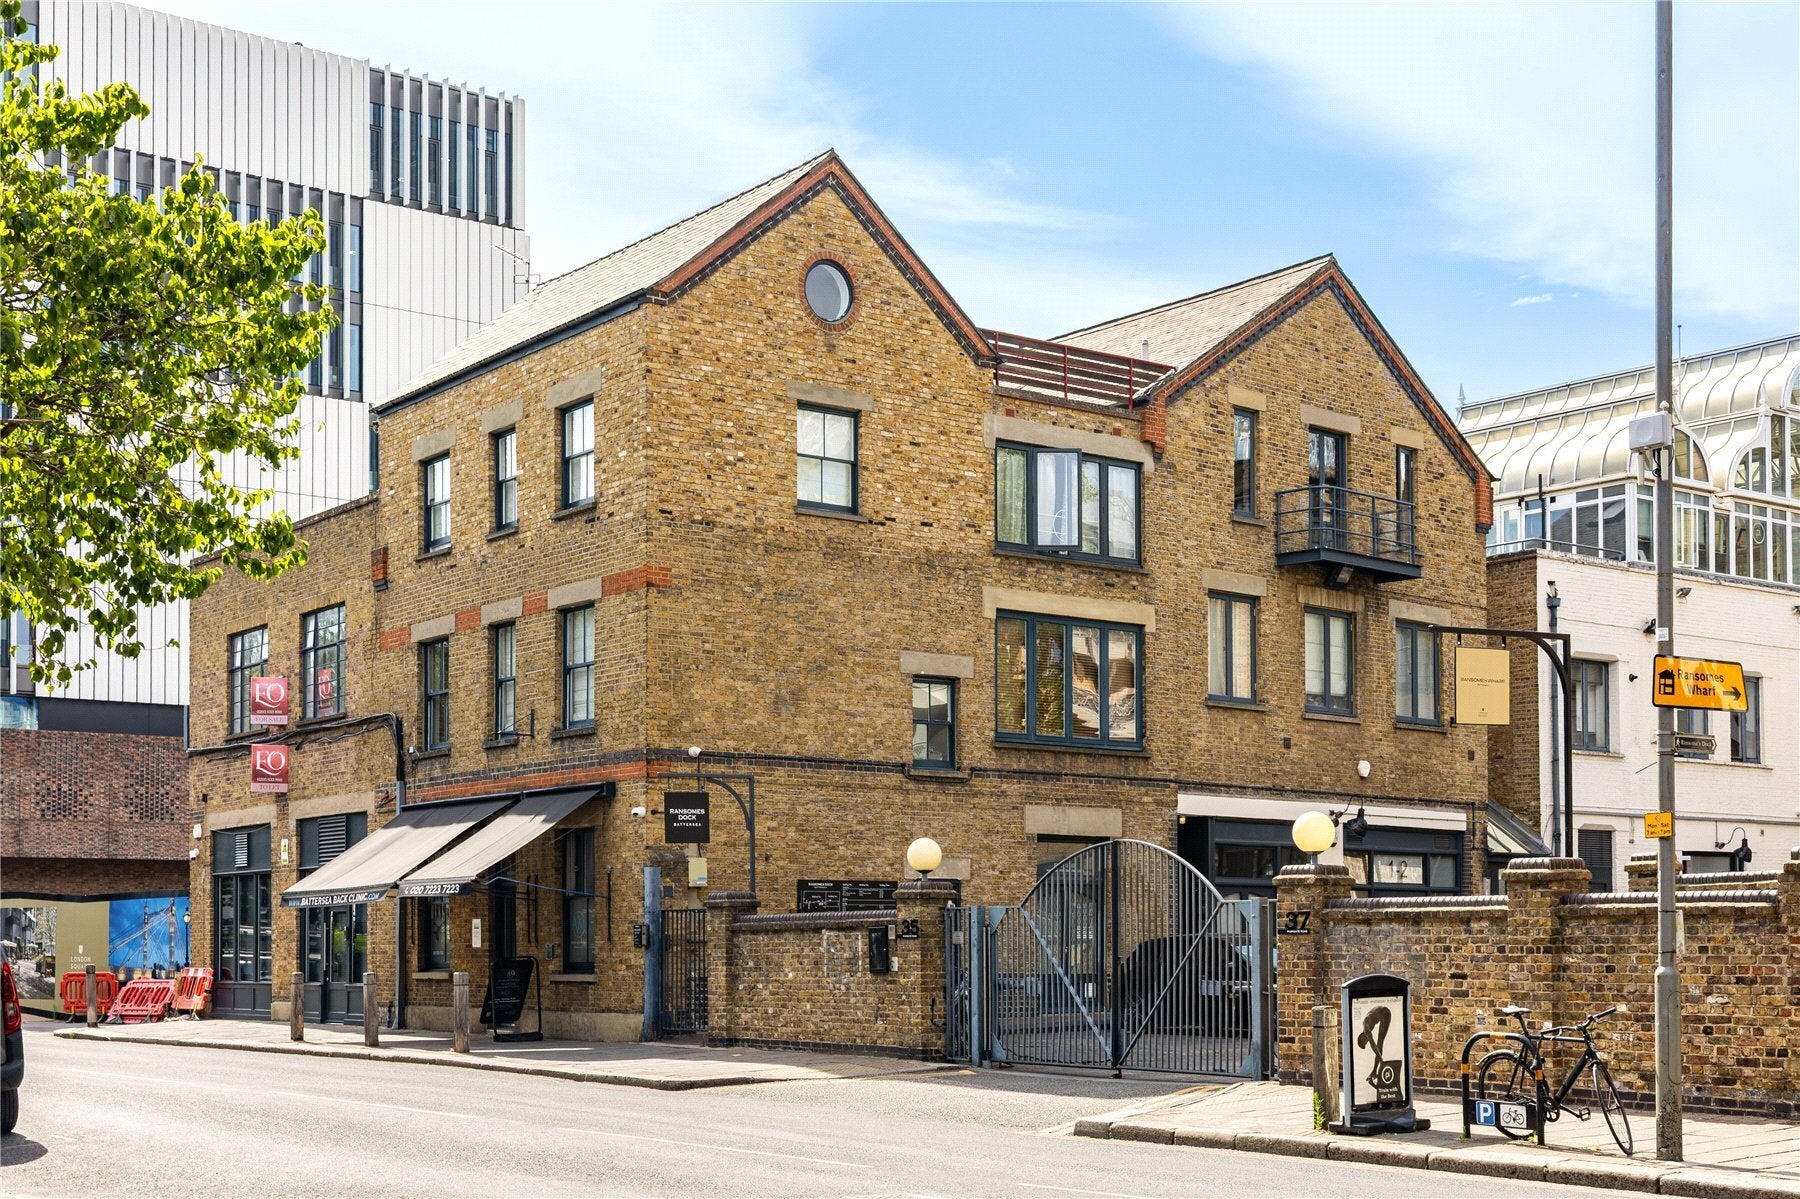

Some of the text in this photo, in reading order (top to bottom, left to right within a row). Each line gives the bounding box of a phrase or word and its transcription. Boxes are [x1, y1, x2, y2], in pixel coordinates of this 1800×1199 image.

[1677, 668, 1725, 683] Ransomes
[1686, 684, 1717, 697] Wharf
[410, 884, 460, 895] 020 7223 7223
[333, 893, 348, 904] BACK
[902, 920, 919, 932] 35
[1285, 911, 1310, 930] 37
[1480, 1103, 1492, 1122] P
